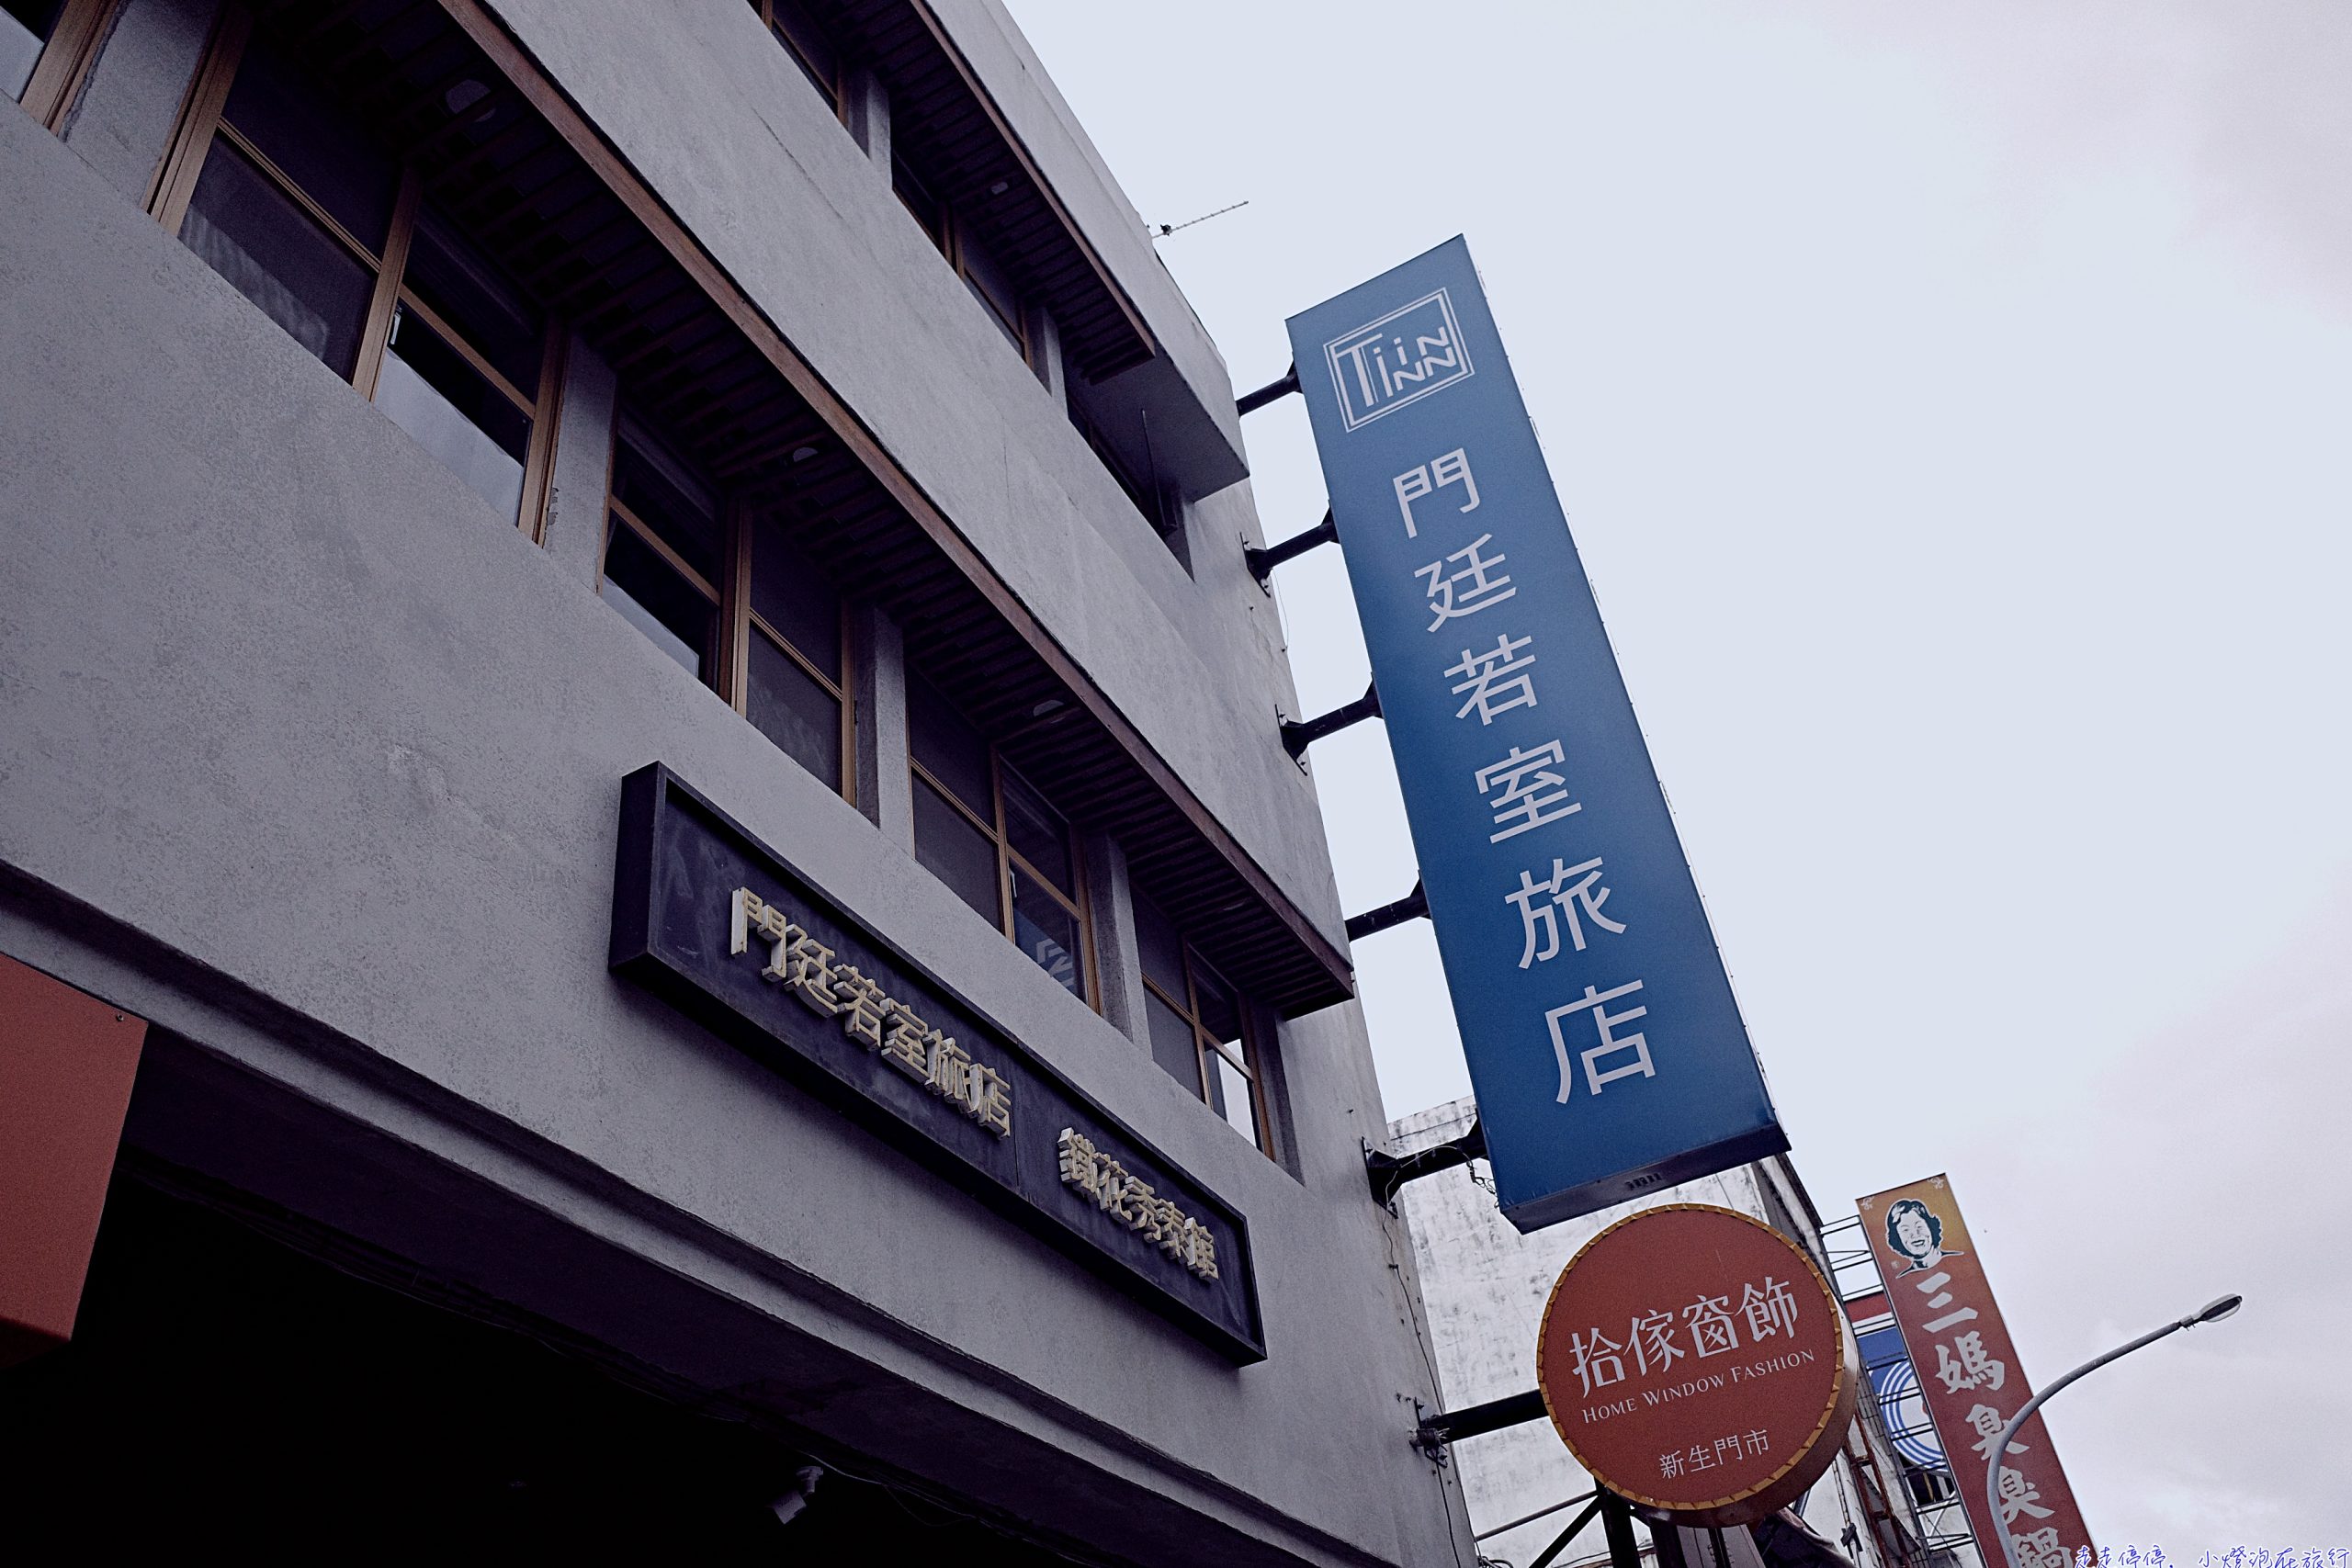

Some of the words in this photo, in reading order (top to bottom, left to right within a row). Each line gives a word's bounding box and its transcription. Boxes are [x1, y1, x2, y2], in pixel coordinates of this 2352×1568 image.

[1393, 447, 1656, 1104] 門廷若室旅店
[730, 886, 1011, 1140] 門廷若室旅店
[1569, 1276, 1799, 1398] 拾傢窗飾
[1659, 1428, 1770, 1479] 新生門市
